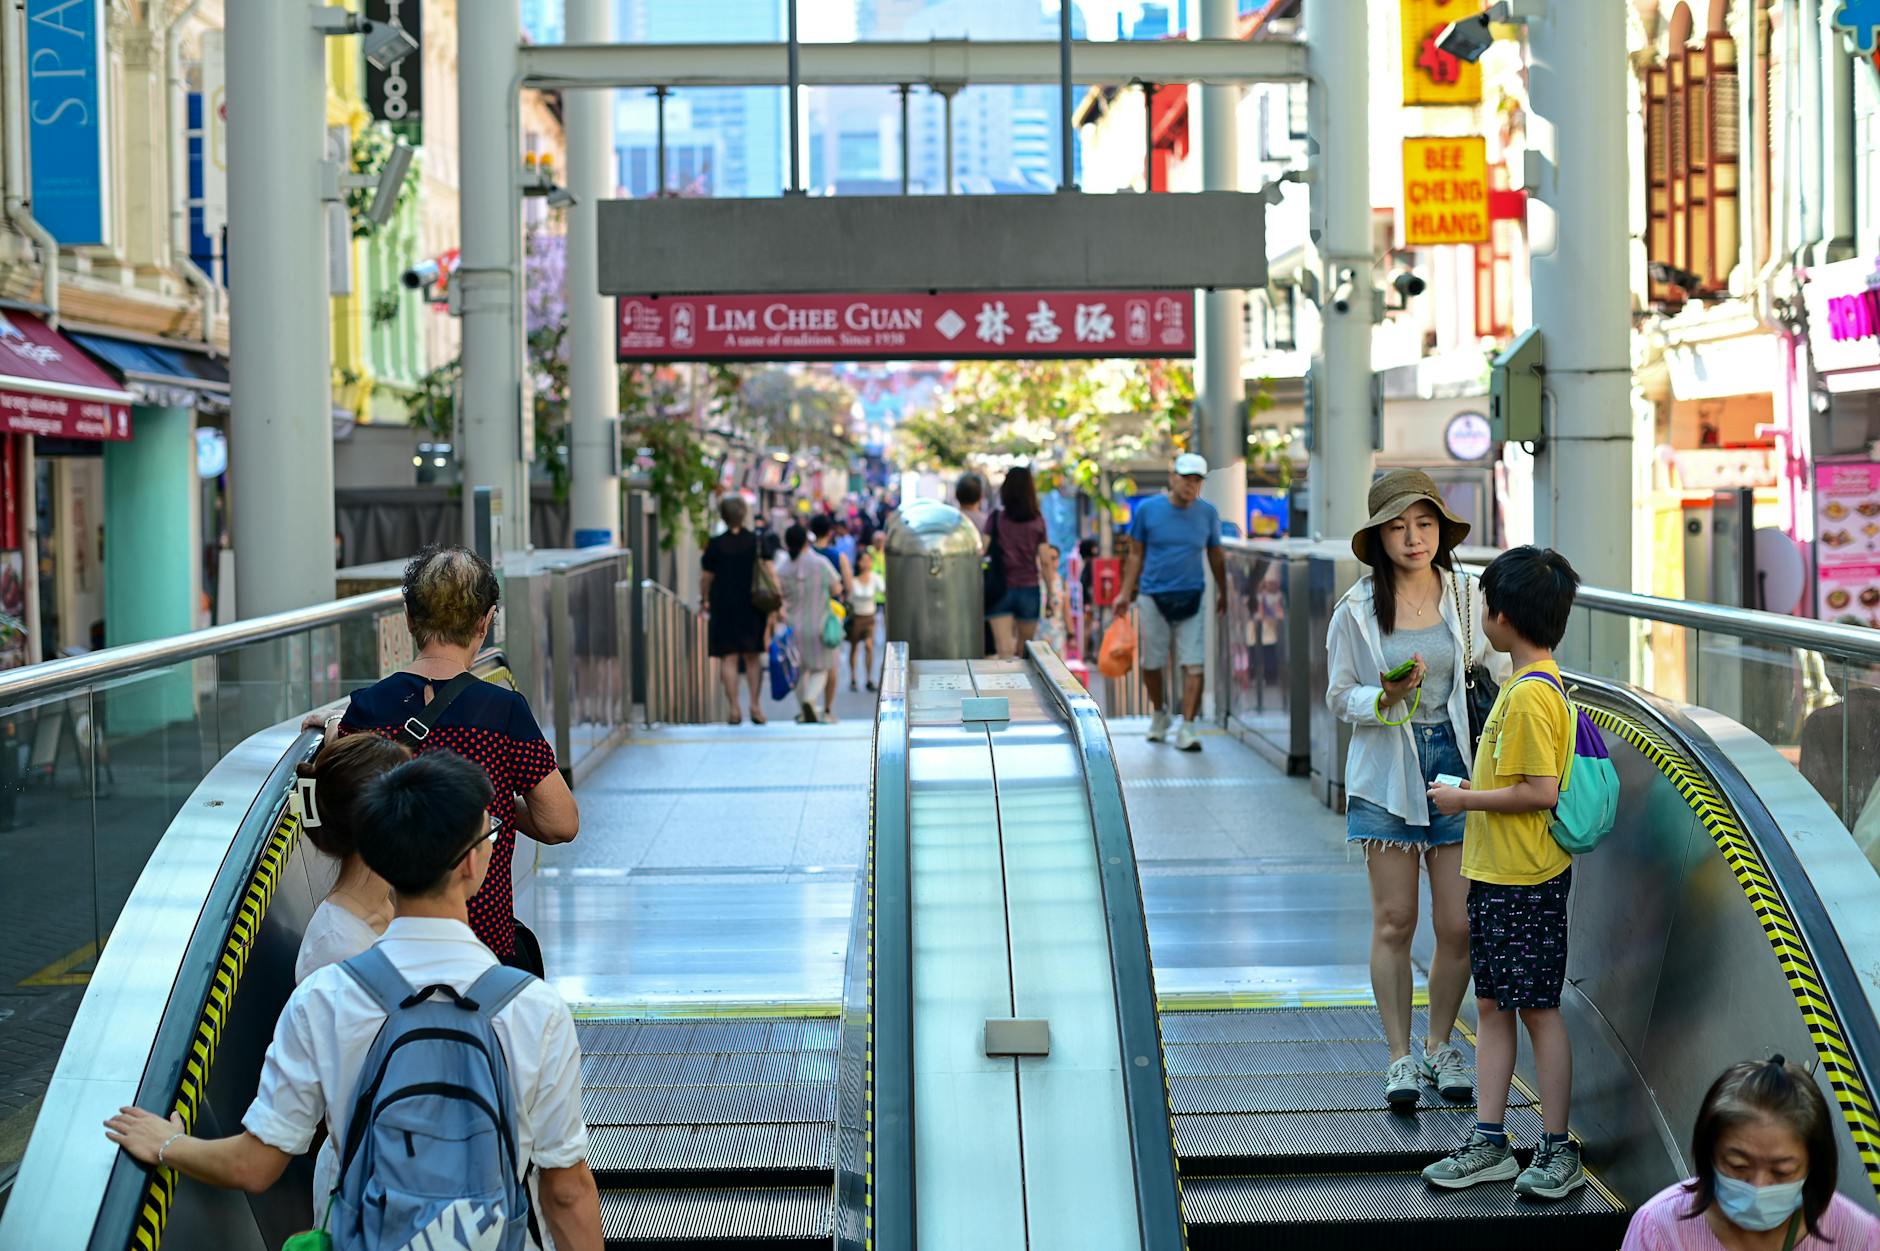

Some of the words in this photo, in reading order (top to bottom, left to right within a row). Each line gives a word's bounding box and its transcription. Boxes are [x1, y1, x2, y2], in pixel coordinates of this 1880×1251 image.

[31, 0, 88, 126] SPA
[1424, 146, 1465, 171] BEE
[1408, 180, 1483, 206] CHENG
[1410, 212, 1483, 237] HIANG
[706, 304, 756, 331] LIM
[763, 303, 839, 331] CHEE
[844, 302, 923, 331] GUAN
[724, 333, 737, 347] A
[738, 334, 764, 347] taste
[766, 333, 781, 347] of
[839, 333, 871, 347] Since
